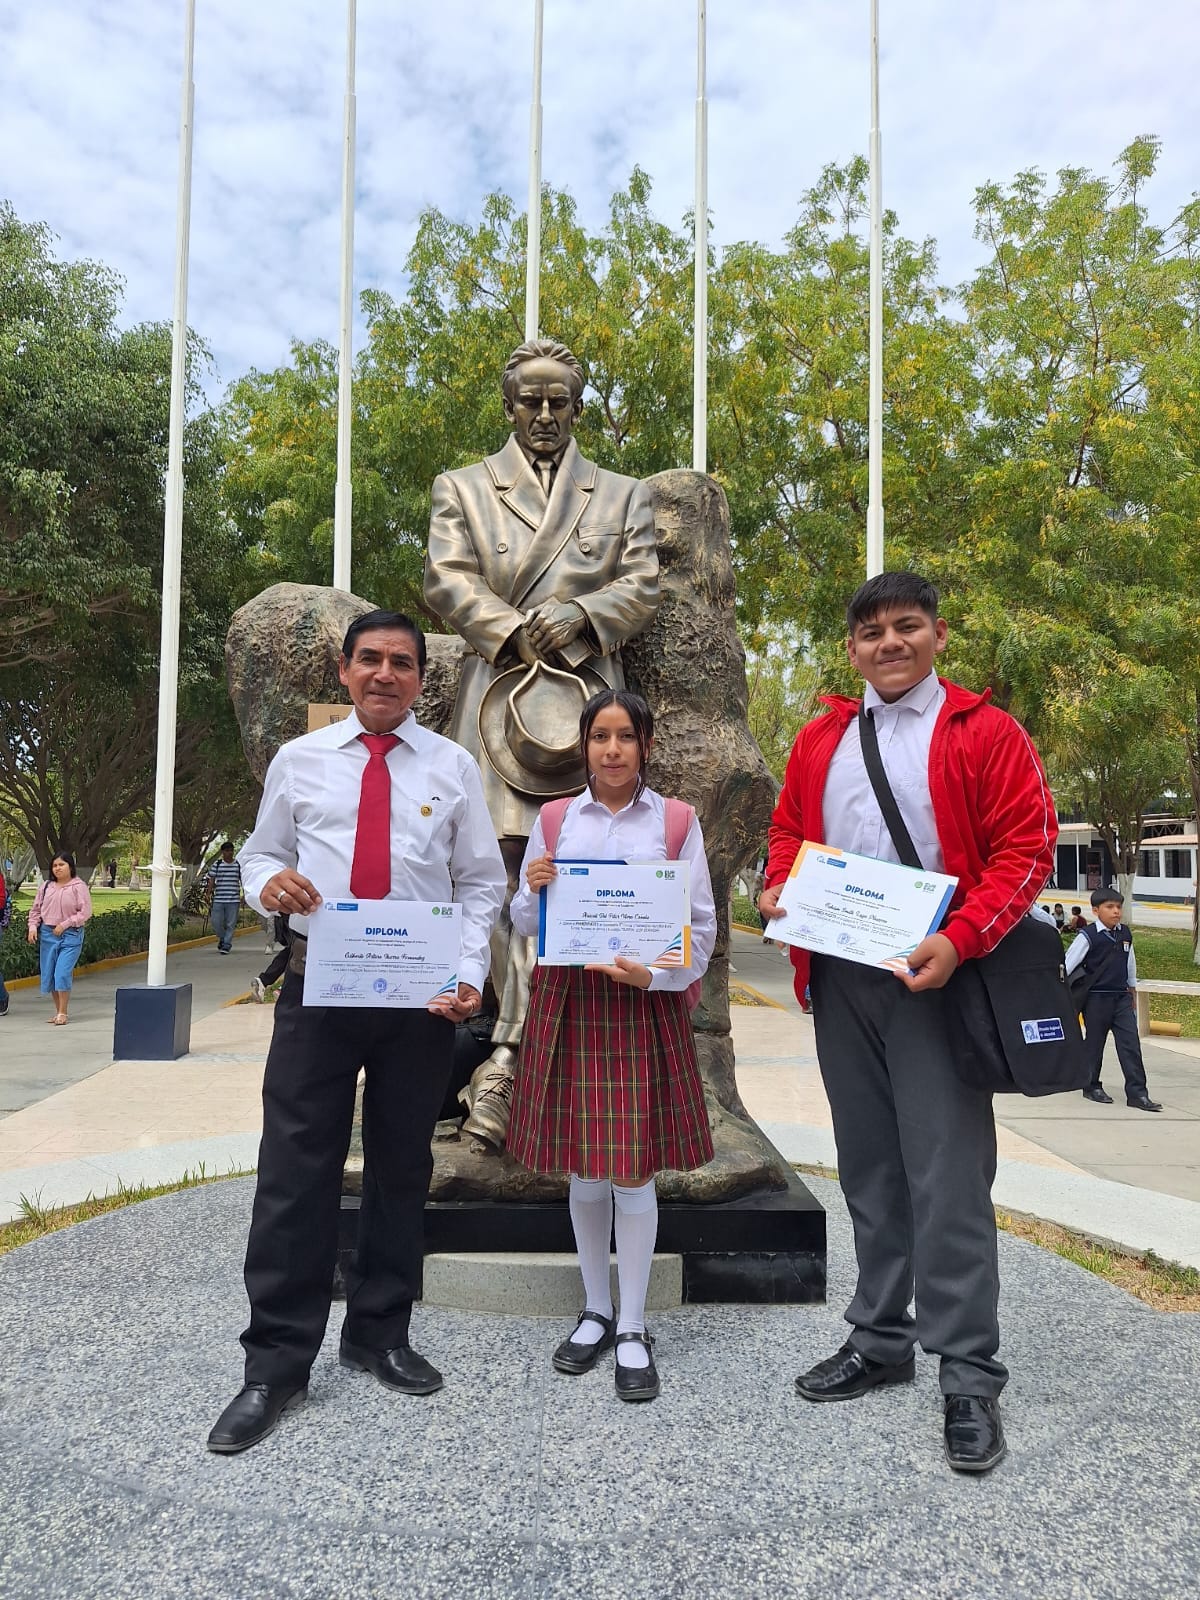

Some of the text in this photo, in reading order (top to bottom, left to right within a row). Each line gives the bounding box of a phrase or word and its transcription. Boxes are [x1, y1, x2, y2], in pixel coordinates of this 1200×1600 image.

[596, 889, 635, 898] DIPLOMA
[845, 884, 885, 900] DIPLOMA
[365, 927, 408, 936] DIPLOMA
